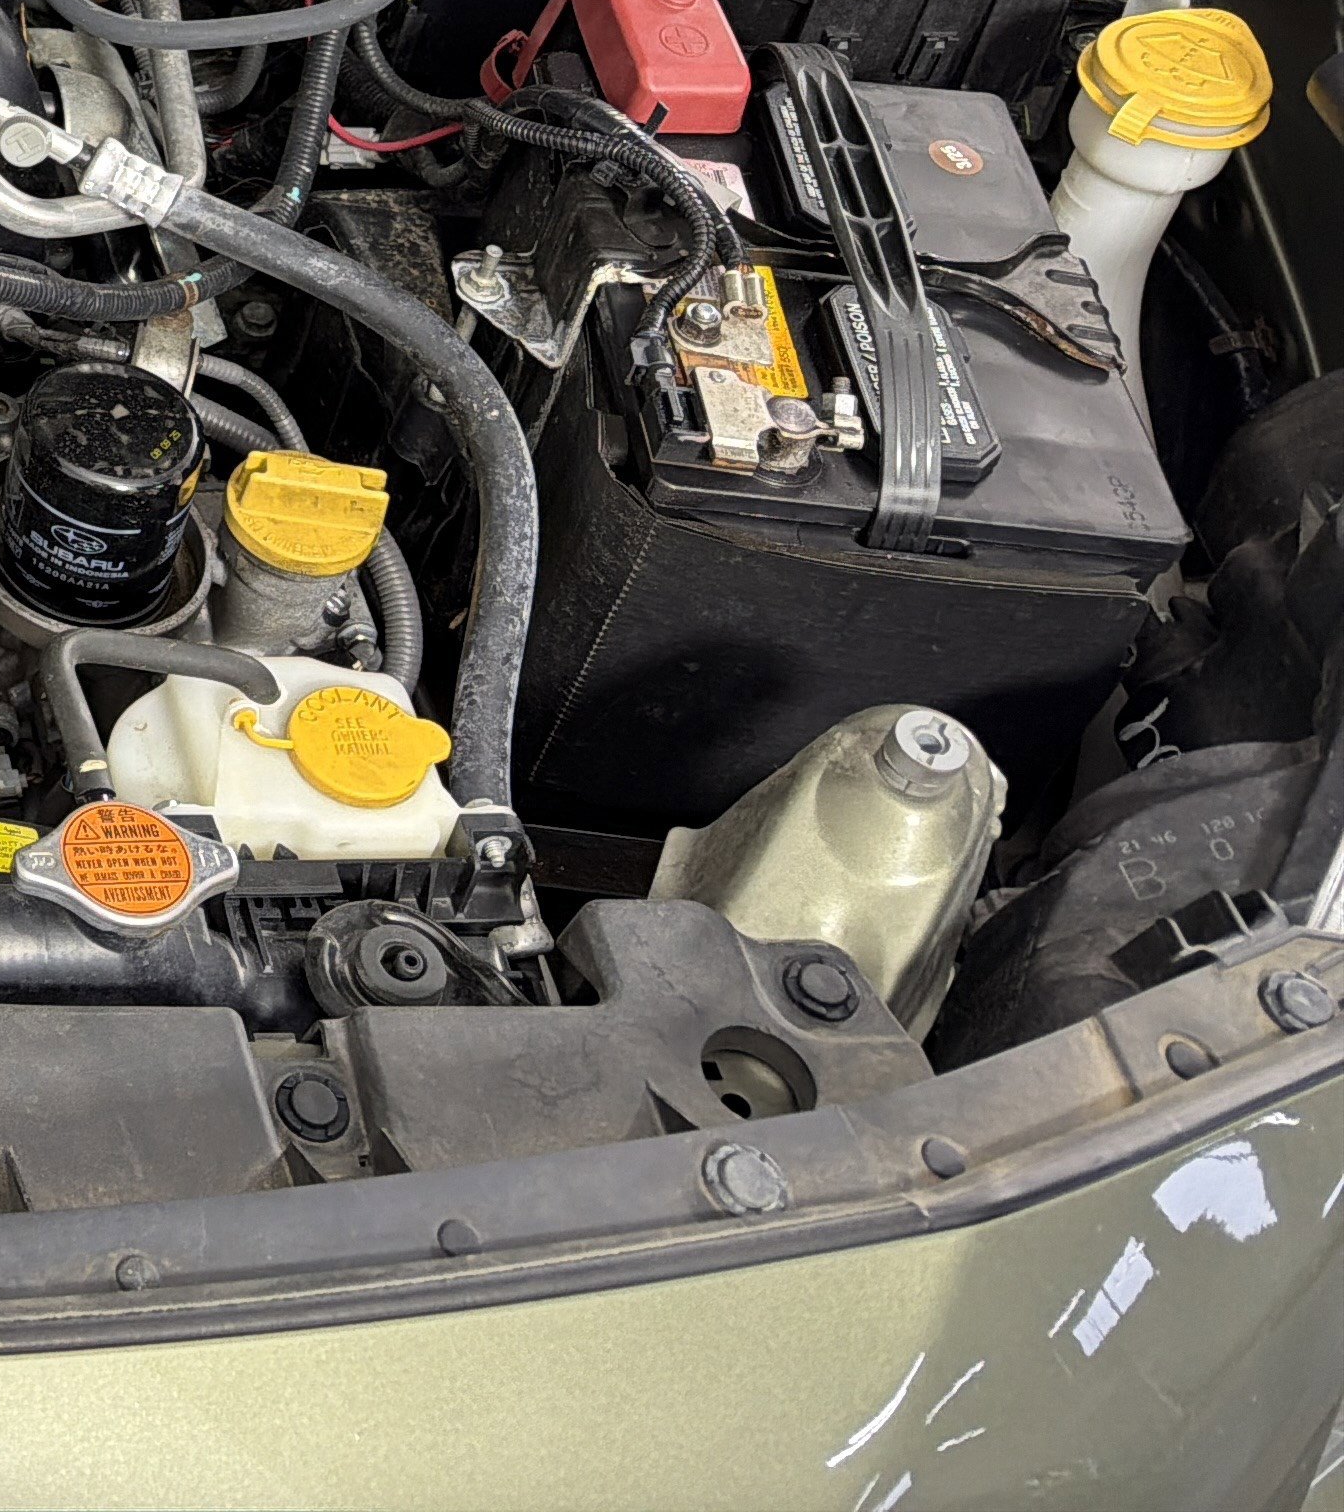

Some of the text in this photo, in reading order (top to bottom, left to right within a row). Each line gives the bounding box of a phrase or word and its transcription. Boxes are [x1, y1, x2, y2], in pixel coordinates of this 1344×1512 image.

[845, 302, 876, 352] POISON
[21, 534, 49, 560] MADE
[50, 554, 63, 567] IN
[64, 562, 130, 579] INDONESIA
[29, 530, 126, 572] SUBARU
[297, 688, 404, 724] COOLANT
[334, 717, 367, 730] SEE
[101, 823, 160, 840] WARNING
[75, 859, 104, 870] NEVER
[107, 858, 130, 868] OPEN
[132, 857, 158, 867] WHEN
[1118, 857, 1166, 901] B
